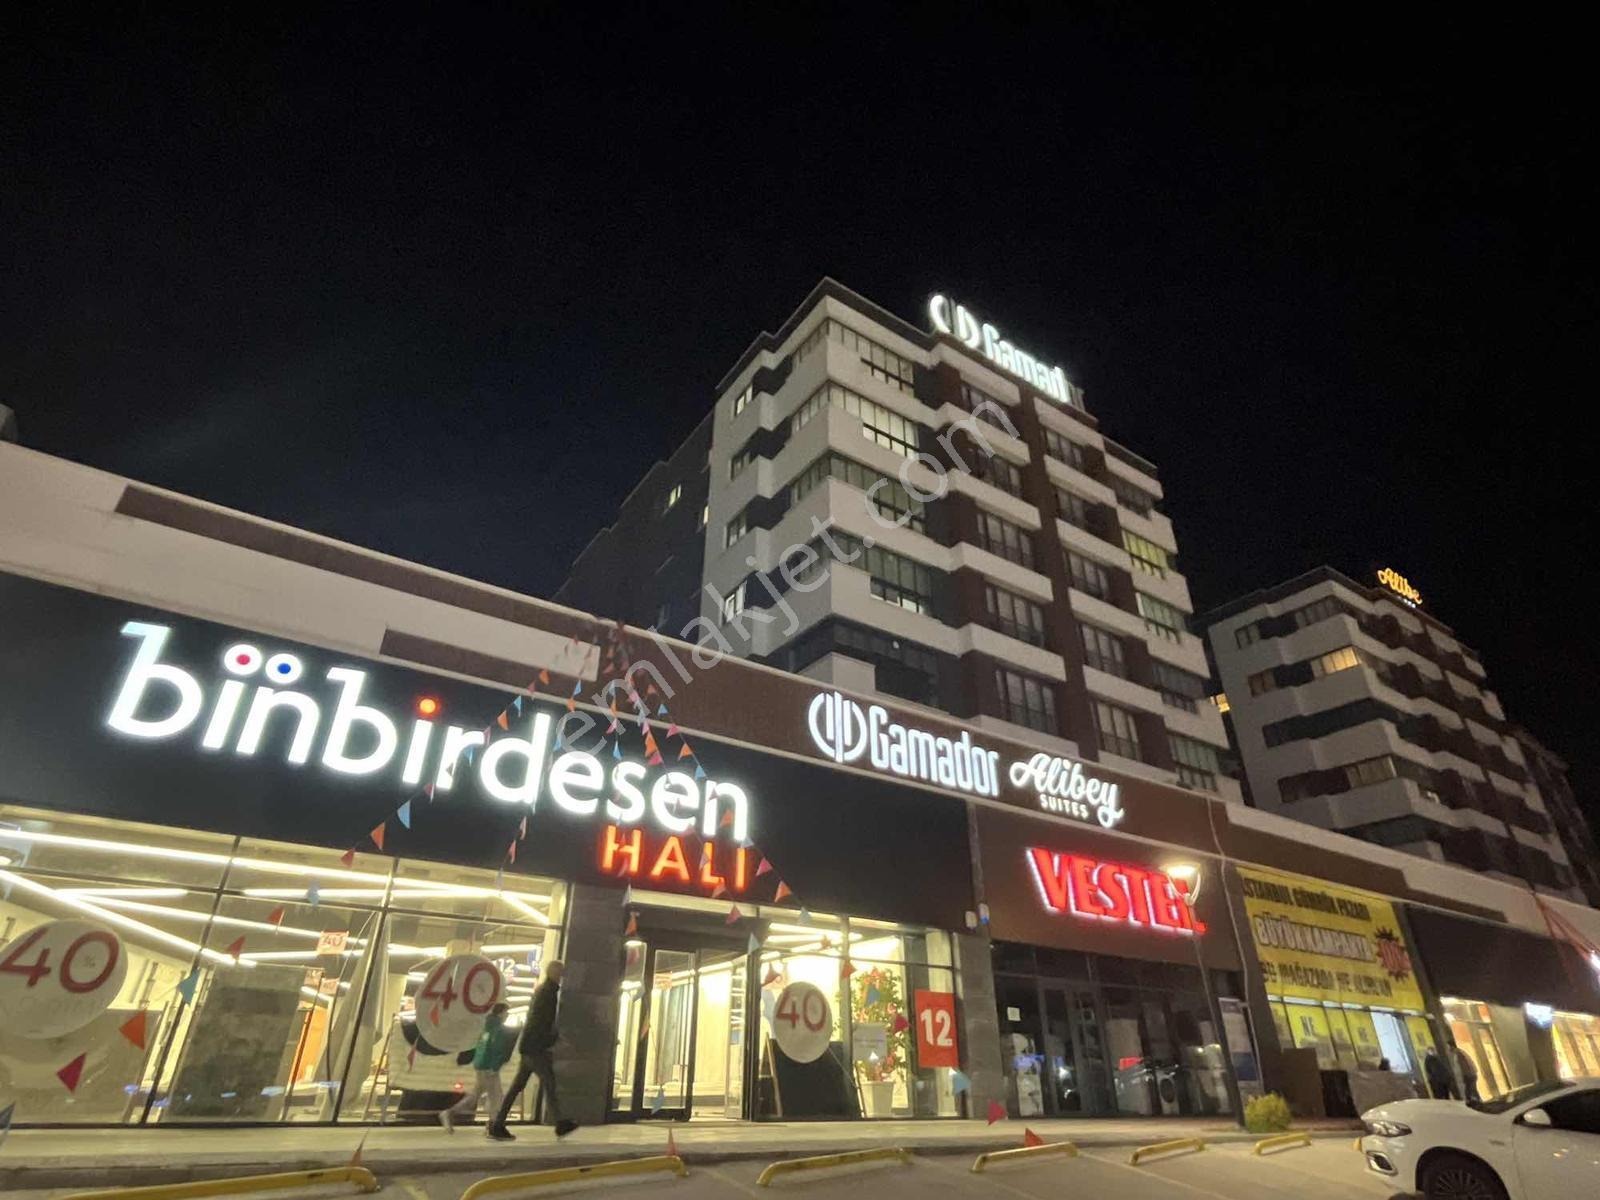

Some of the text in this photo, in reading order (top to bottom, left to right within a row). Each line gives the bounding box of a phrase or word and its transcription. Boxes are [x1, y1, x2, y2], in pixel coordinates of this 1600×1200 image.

[107, 620, 749, 842] binbirdesen
[868, 704, 1000, 798] Gamador
[1009, 752, 1124, 829] Alibey
[1039, 793, 1088, 819] SUITES
[602, 824, 747, 891] HALI
[0, 928, 120, 994] 40
[421, 959, 501, 1015] 40
[776, 987, 827, 1032] 40
[920, 1008, 954, 1047] 12
